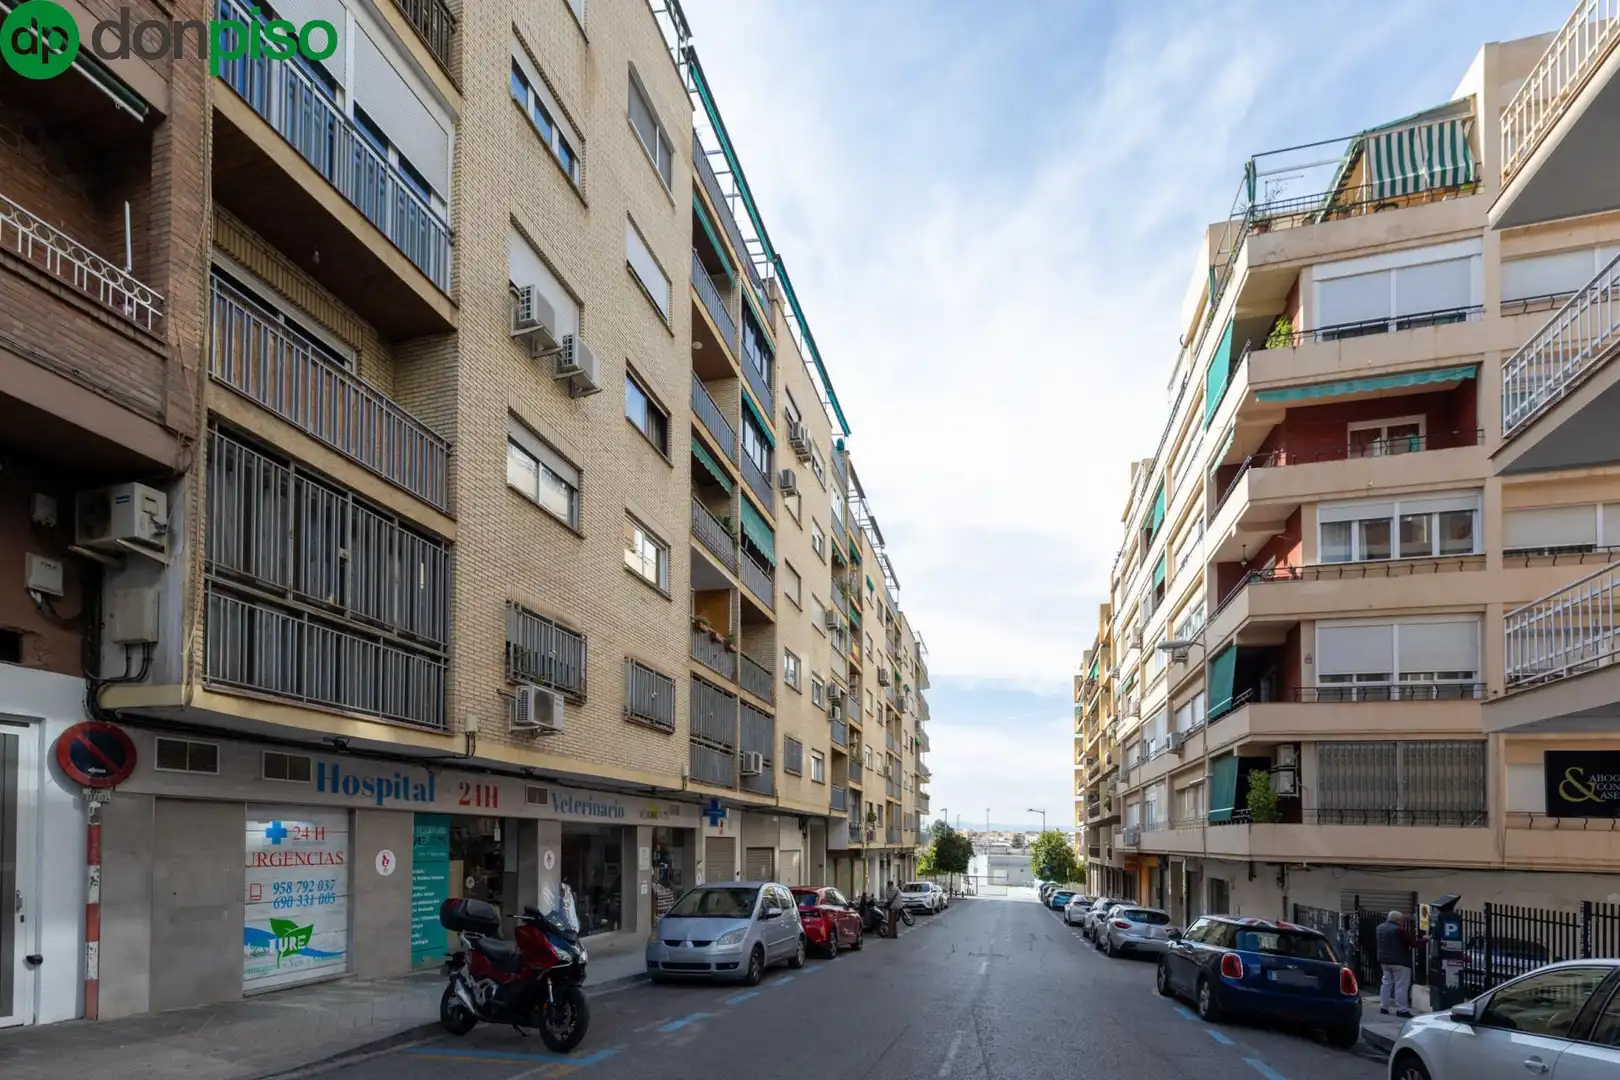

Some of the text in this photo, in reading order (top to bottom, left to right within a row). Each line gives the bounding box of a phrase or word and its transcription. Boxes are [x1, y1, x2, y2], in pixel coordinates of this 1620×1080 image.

[316, 762, 625, 819] Hospital 24H Veterinario
[272, 879, 336, 895] 958 792 037
[272, 896, 294, 909] 690
[1445, 923, 1458, 936] P
